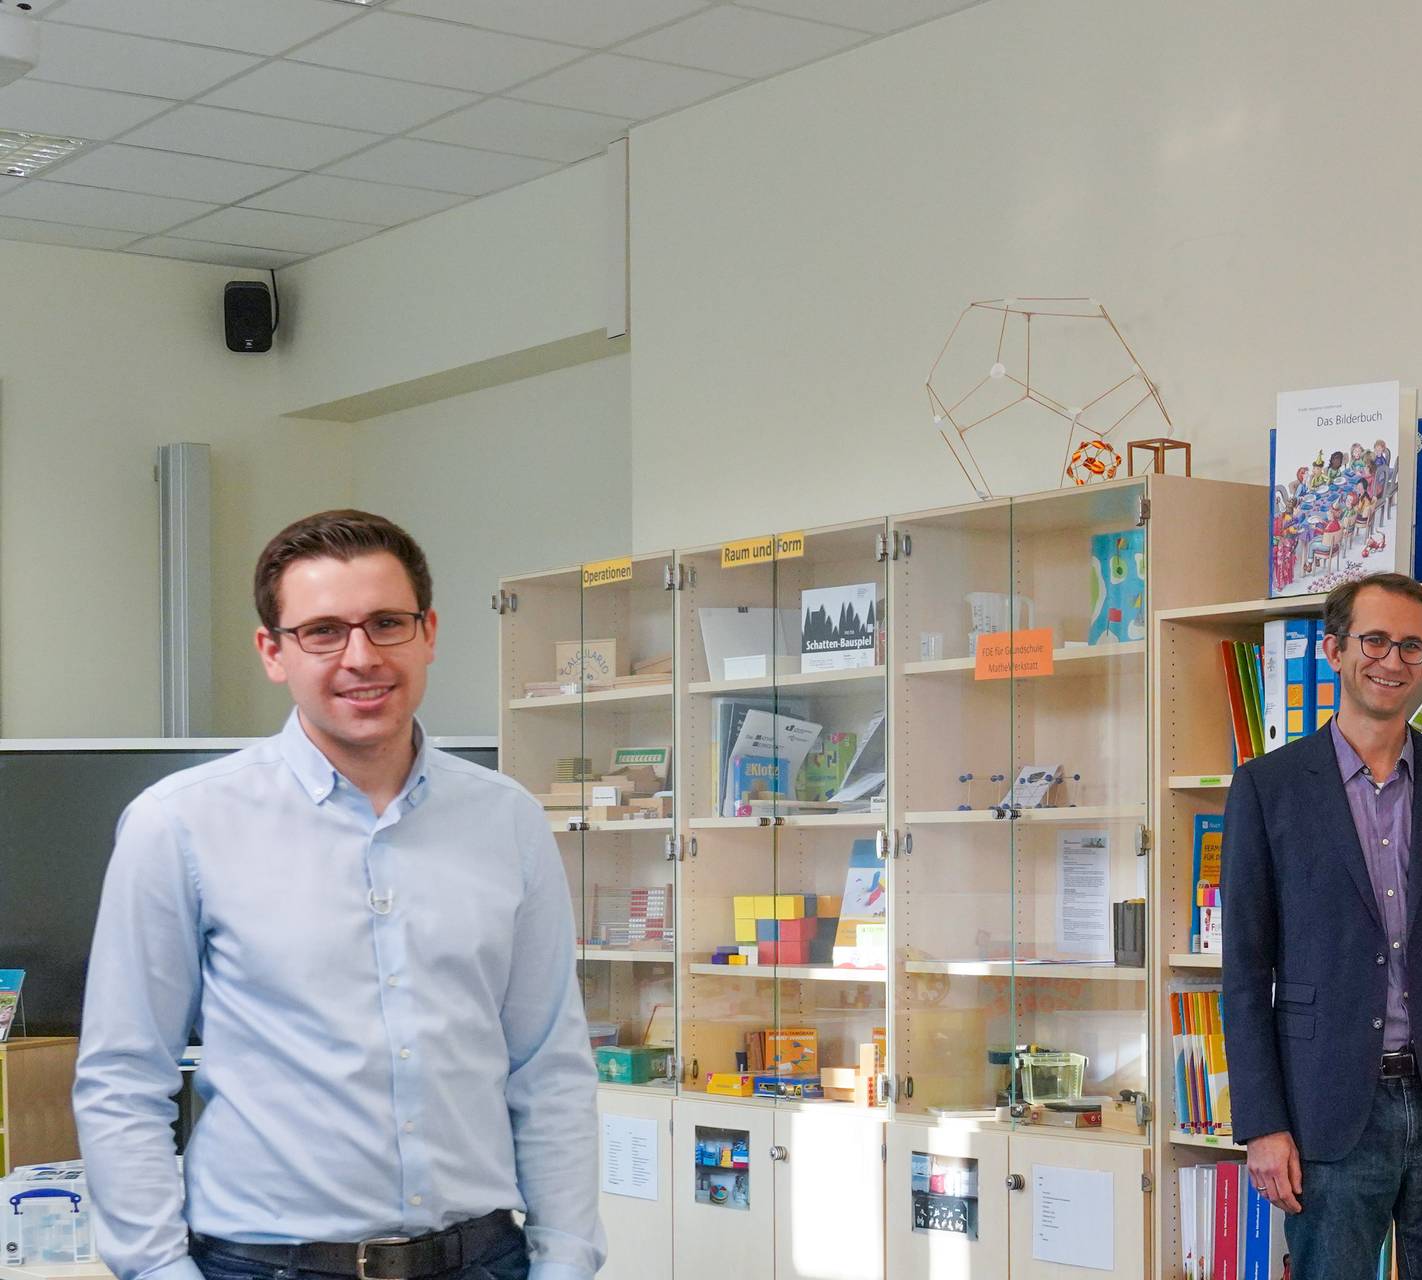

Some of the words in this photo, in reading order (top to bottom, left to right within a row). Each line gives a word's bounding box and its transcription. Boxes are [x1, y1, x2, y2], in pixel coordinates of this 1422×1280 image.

[1316, 416, 1334, 427] Das
[1335, 410, 1383, 425] Bilderbuch
[724, 547, 750, 562] Raum
[752, 541, 772, 558] und
[777, 538, 802, 553] Form
[583, 566, 632, 584] Operationen
[805, 635, 872, 650] Schatten-Bauspiel
